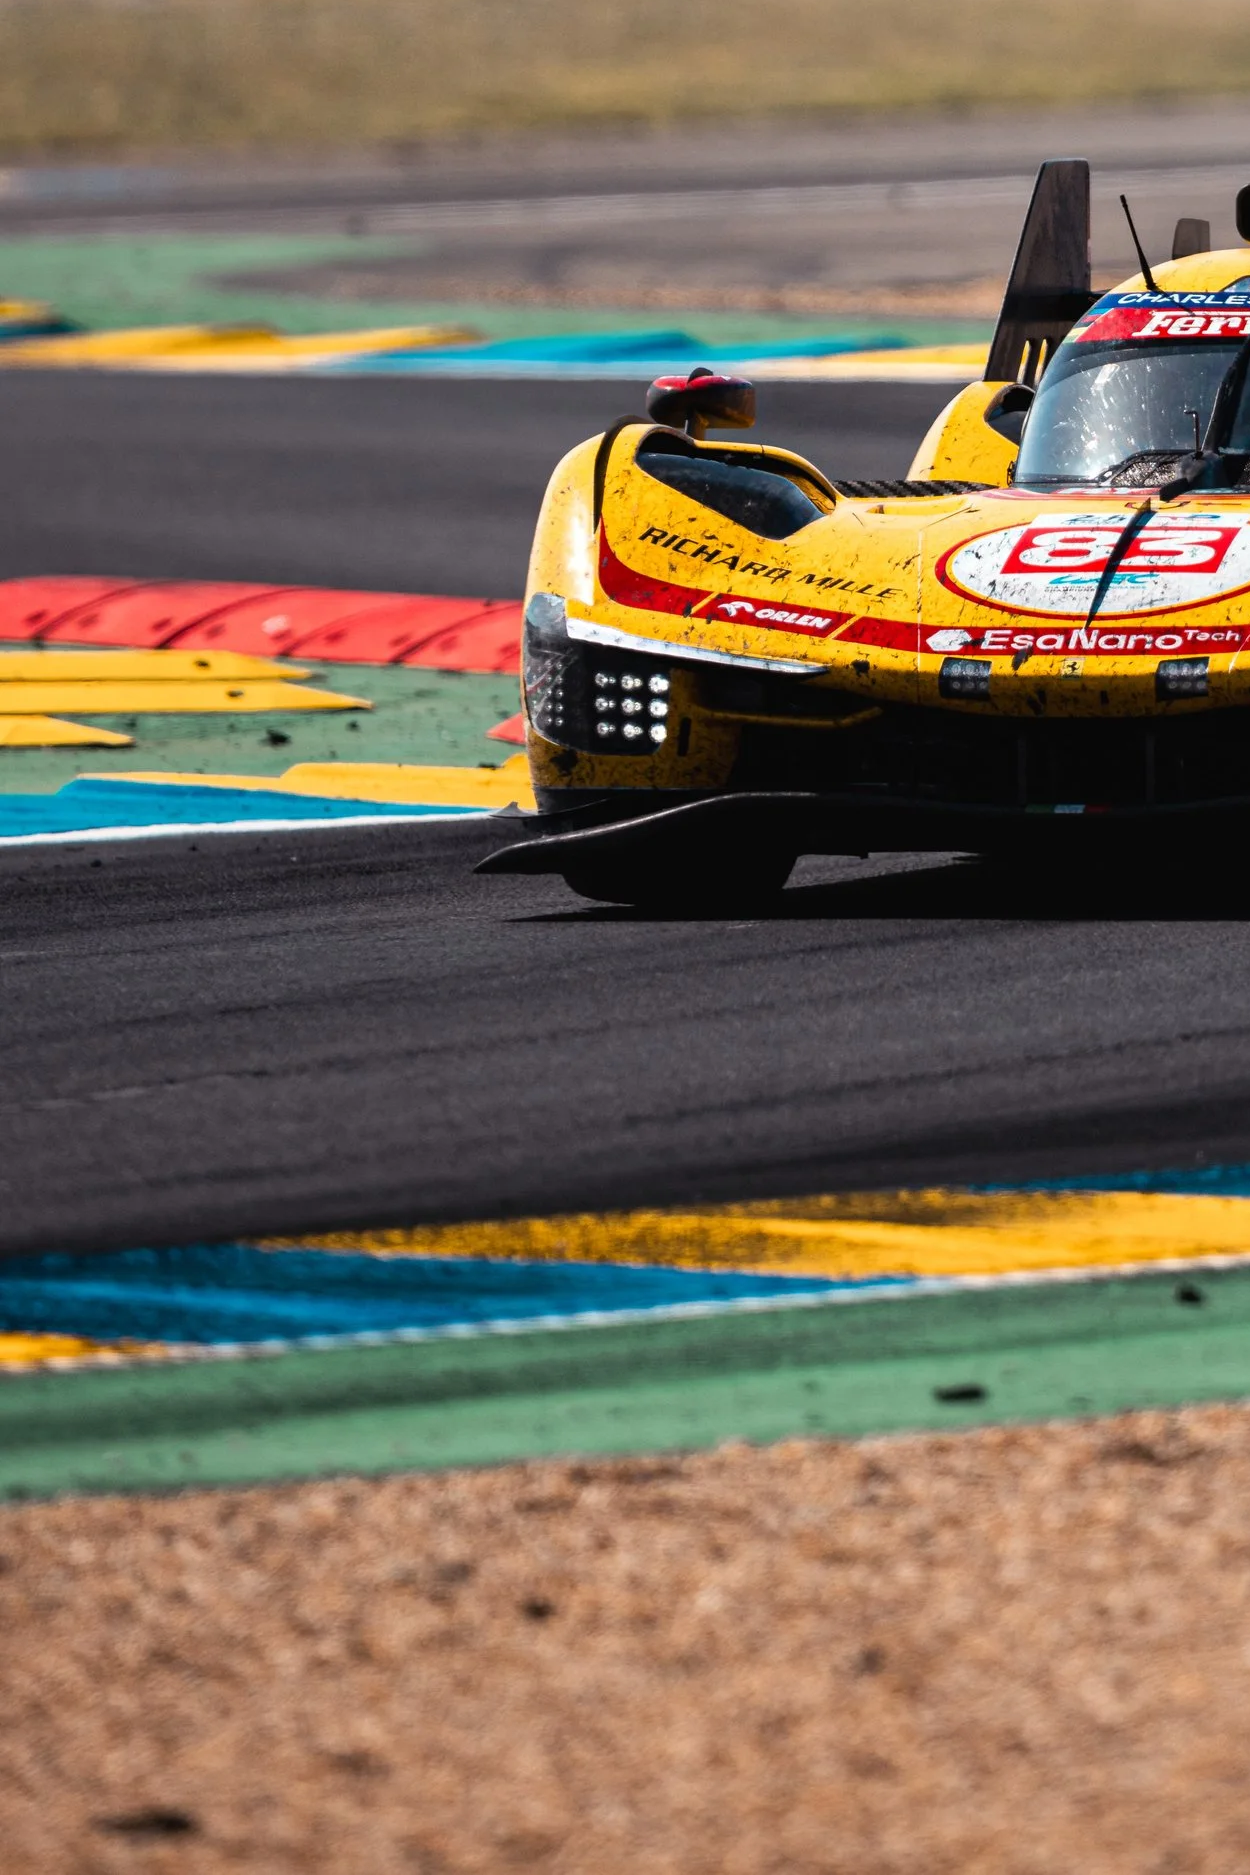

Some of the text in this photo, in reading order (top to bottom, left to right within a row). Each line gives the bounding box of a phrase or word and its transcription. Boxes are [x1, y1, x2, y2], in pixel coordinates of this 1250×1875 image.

[637, 526, 903, 599] RICHARD MILLE
[1019, 530, 1223, 567] 83
[755, 608, 832, 629] ORLEN
